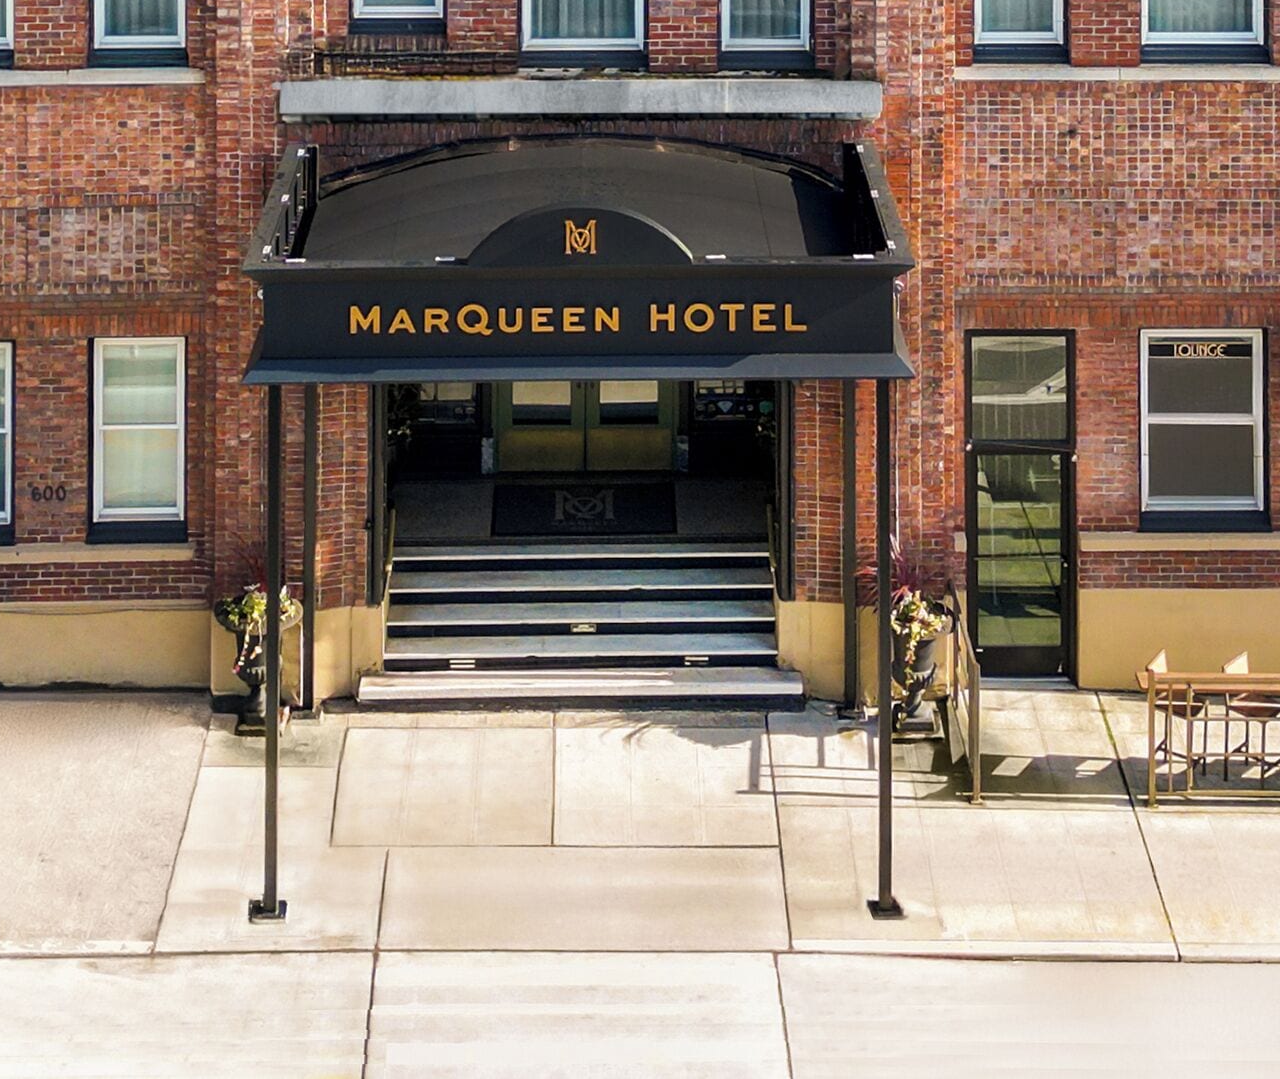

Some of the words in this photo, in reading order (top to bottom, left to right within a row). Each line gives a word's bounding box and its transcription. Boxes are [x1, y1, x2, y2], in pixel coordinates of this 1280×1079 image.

[348, 303, 620, 336] MARQUEEN
[649, 302, 808, 333] HOTEL
[1173, 343, 1228, 358] LOUNGE
[31, 485, 67, 502] 600
